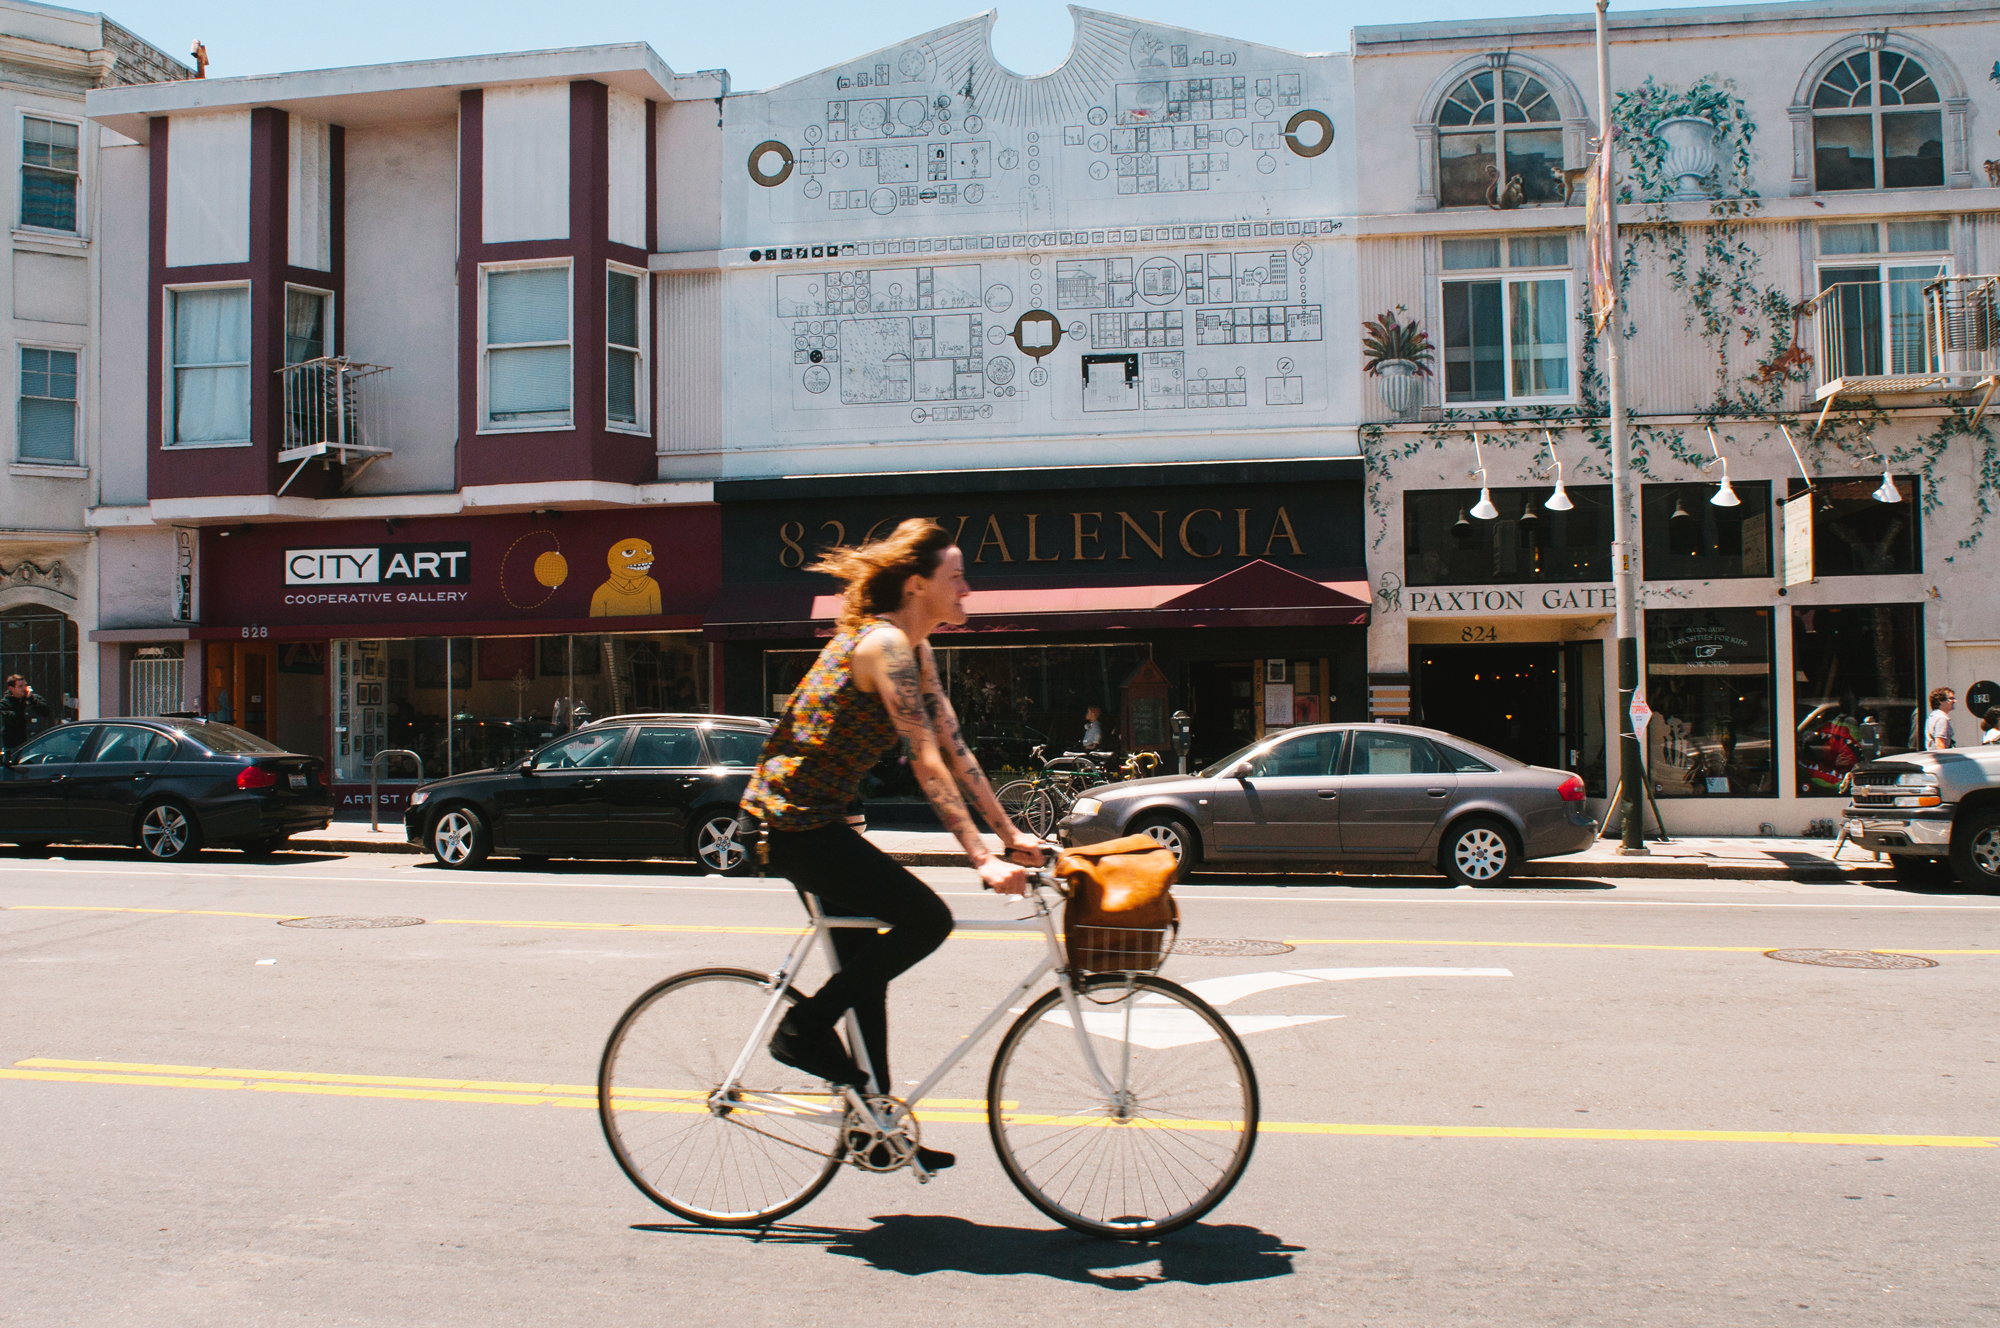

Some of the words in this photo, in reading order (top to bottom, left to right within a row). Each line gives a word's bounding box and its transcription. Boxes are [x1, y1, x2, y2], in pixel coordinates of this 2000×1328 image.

[181, 531, 192, 568] CITY
[290, 553, 373, 580] CITY
[384, 551, 467, 579] ART
[182, 578, 191, 617] ART
[285, 592, 392, 605] COOPERATIVE
[396, 591, 468, 602] GALLERY
[1409, 590, 1525, 612] PAXTON
[1541, 588, 1617, 609] GATE
[241, 626, 268, 638] 828
[1461, 626, 1498, 642] 824
[1714, 634, 1730, 642] FOR
[343, 794, 400, 805] ARTST
